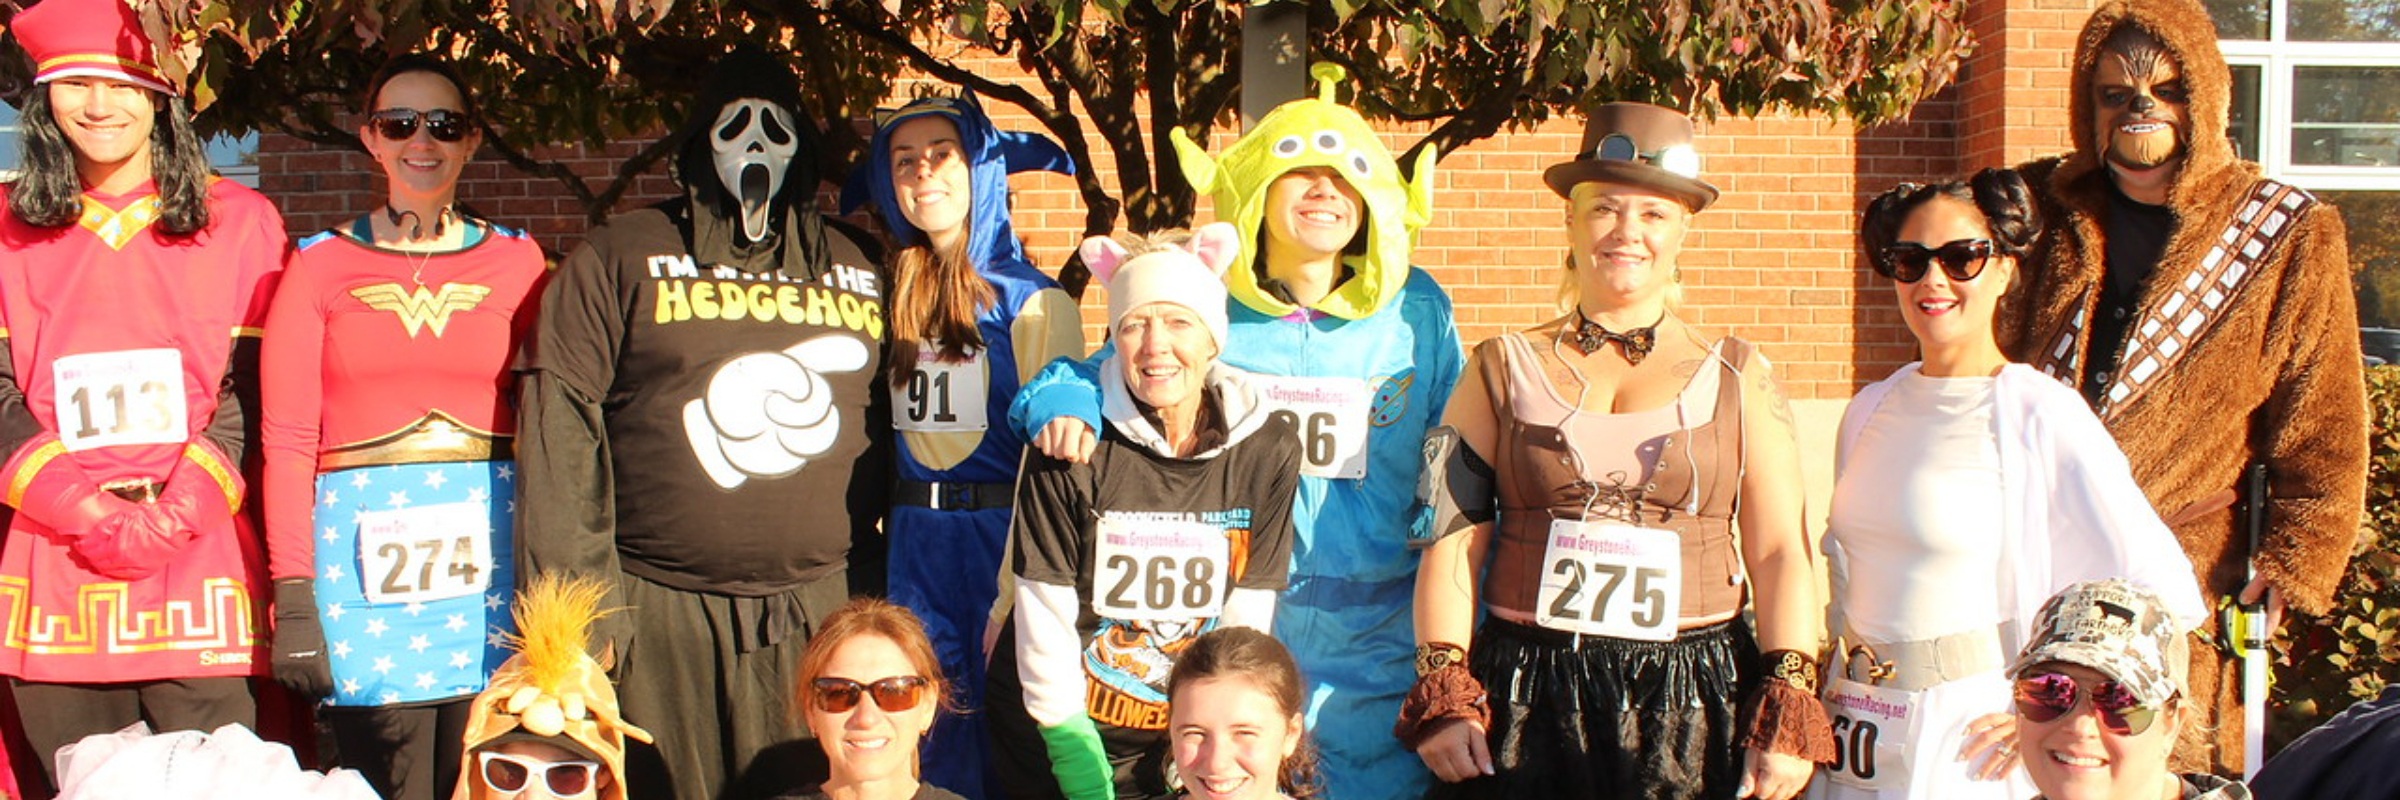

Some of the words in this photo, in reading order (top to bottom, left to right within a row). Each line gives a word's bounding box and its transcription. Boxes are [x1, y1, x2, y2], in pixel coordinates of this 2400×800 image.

[647, 254, 698, 277] I'M
[655, 280, 882, 340] HEDGEHOG
[71, 380, 173, 438] 113
[908, 369, 957, 422] 91
[378, 536, 479, 594] 274
[1104, 554, 1214, 610] 268
[1550, 558, 1667, 628] 275
